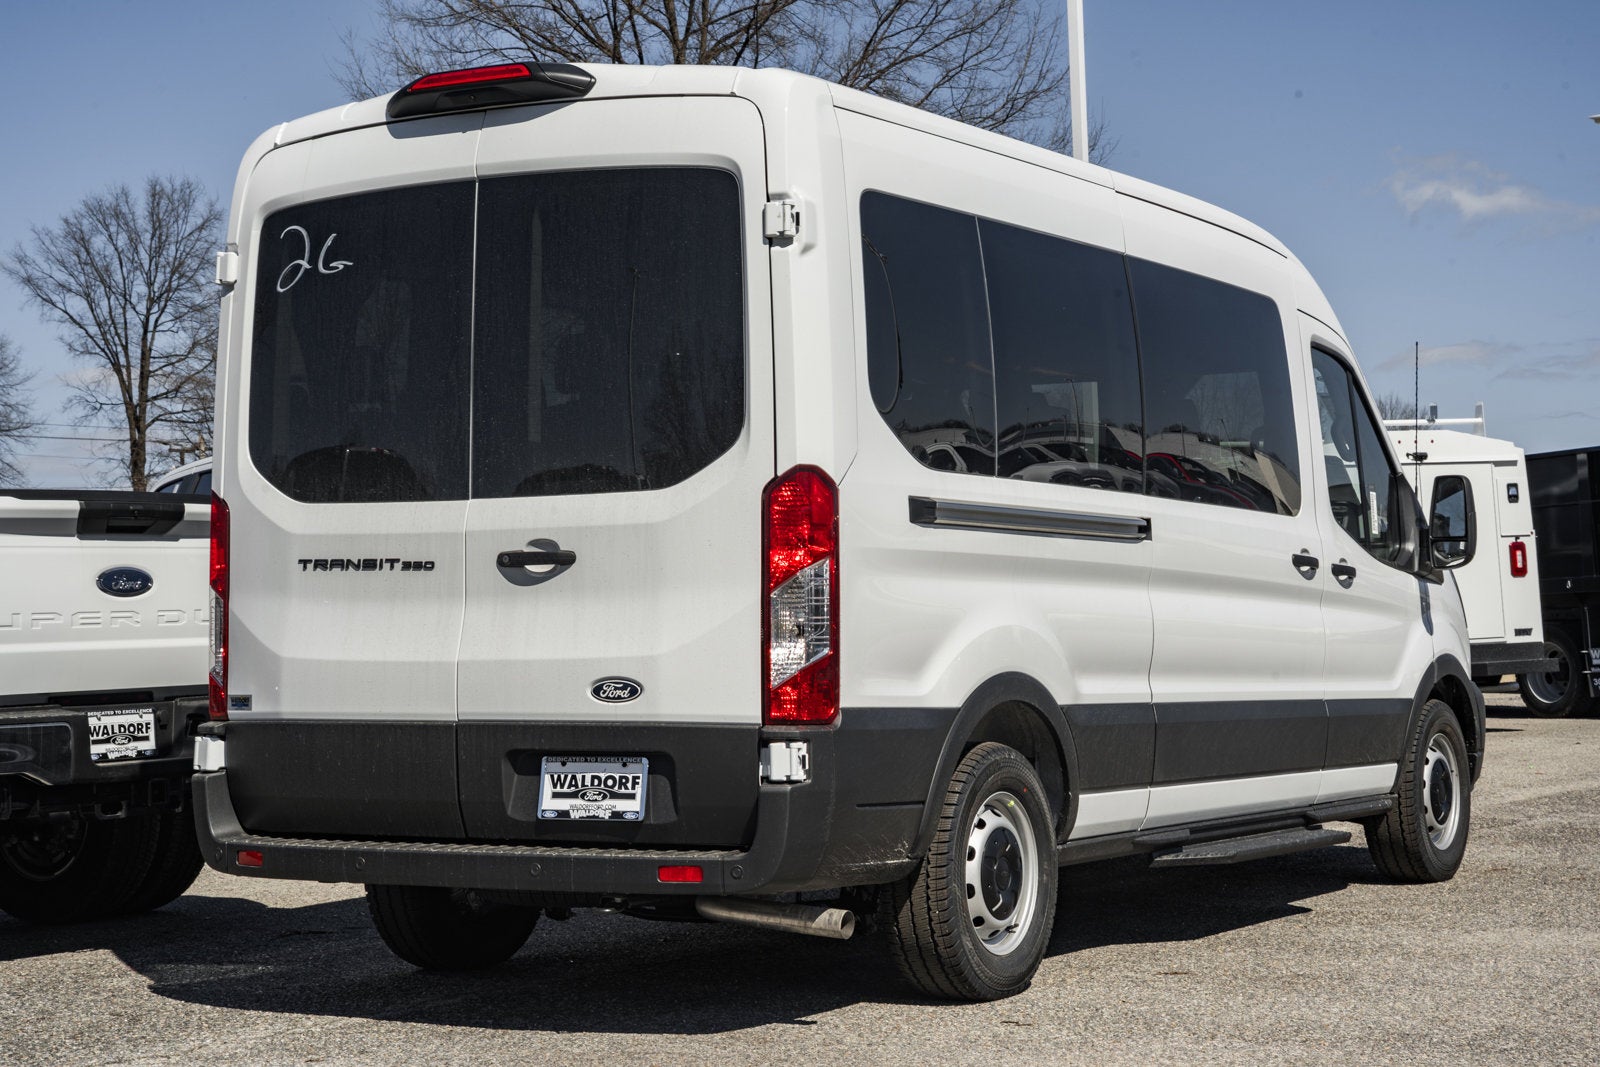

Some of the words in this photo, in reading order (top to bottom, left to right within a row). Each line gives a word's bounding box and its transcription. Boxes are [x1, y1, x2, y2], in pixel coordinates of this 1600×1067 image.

[111, 574, 142, 590] Ford
[600, 683, 631, 698] Ford
[89, 722, 151, 737] WALDORF
[549, 774, 641, 790] WALDORF
[584, 791, 603, 801] Ford
[569, 809, 612, 819] WALDORF
